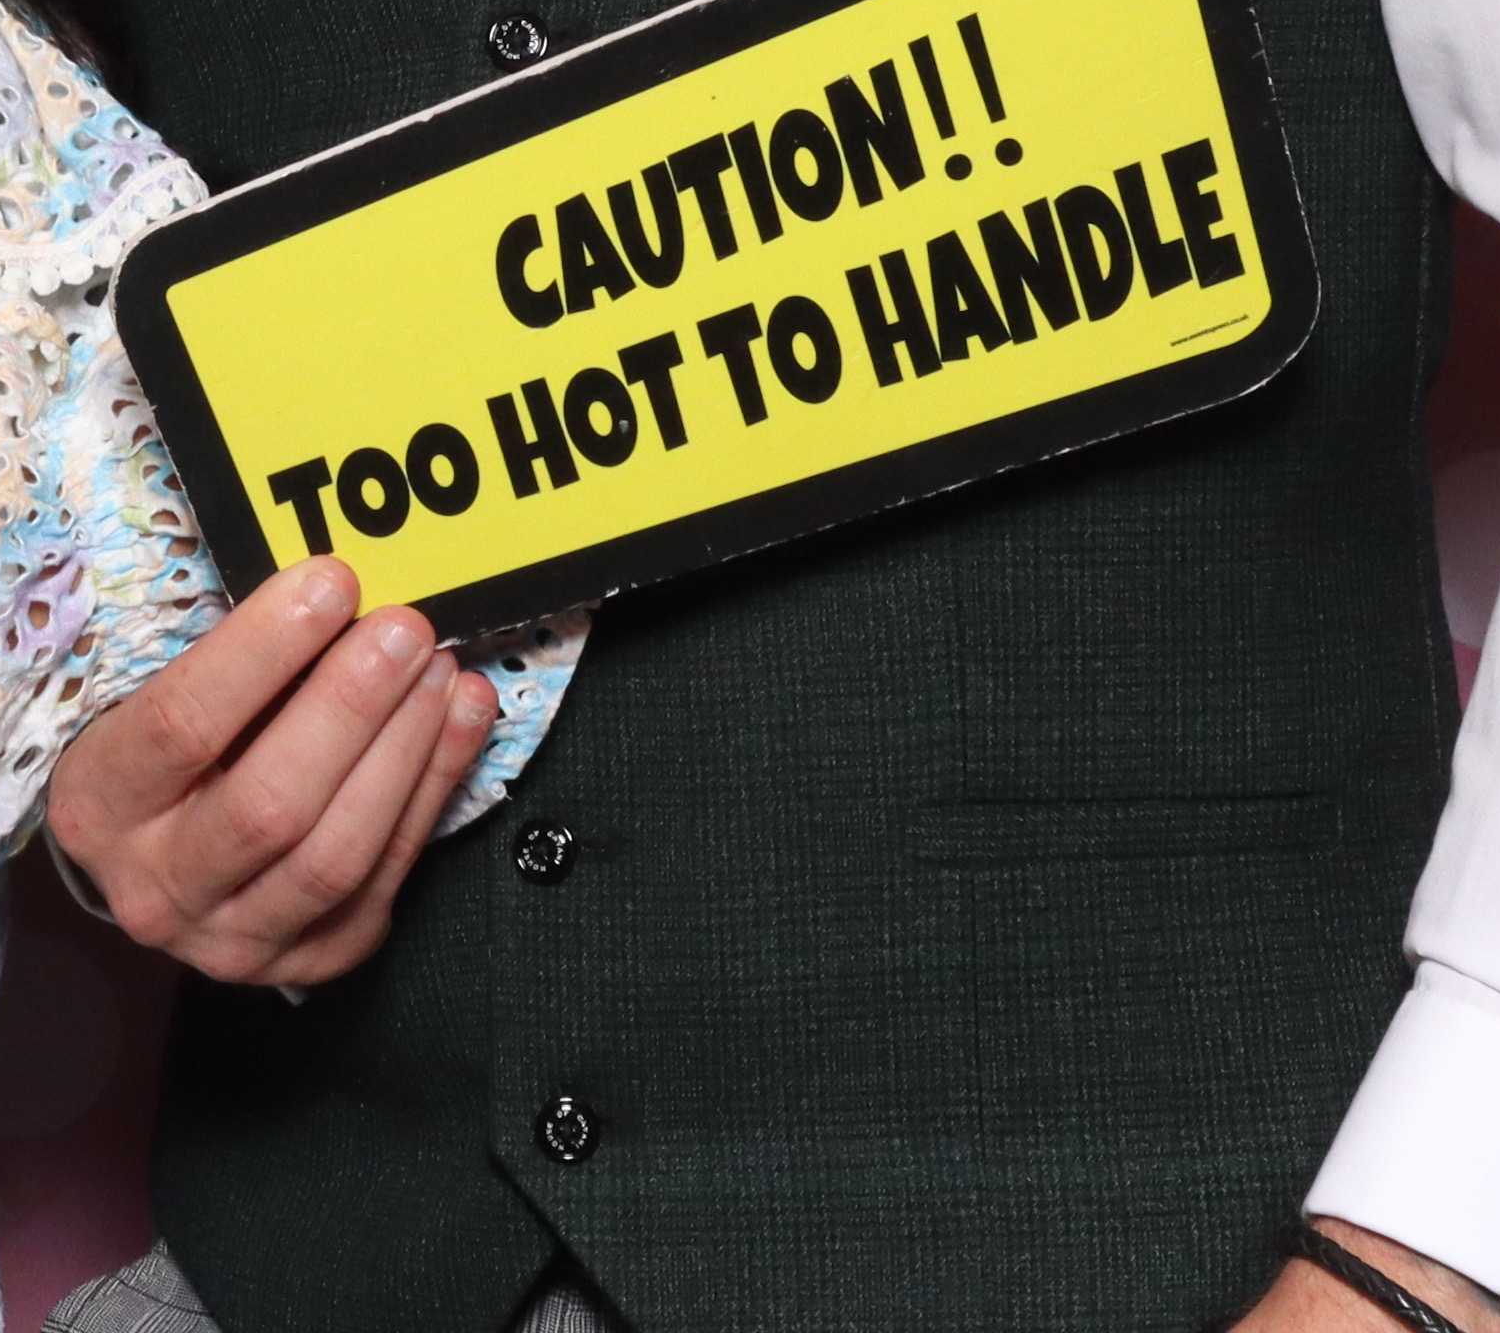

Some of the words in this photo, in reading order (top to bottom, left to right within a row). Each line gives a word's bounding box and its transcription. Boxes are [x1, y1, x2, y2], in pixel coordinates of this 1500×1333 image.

[268, 423, 479, 556] TOO
[487, 332, 687, 498] HOT
[697, 296, 841, 426] TO
[846, 139, 1244, 388] HANDLE
[496, 14, 1022, 328] CAUTION!!
